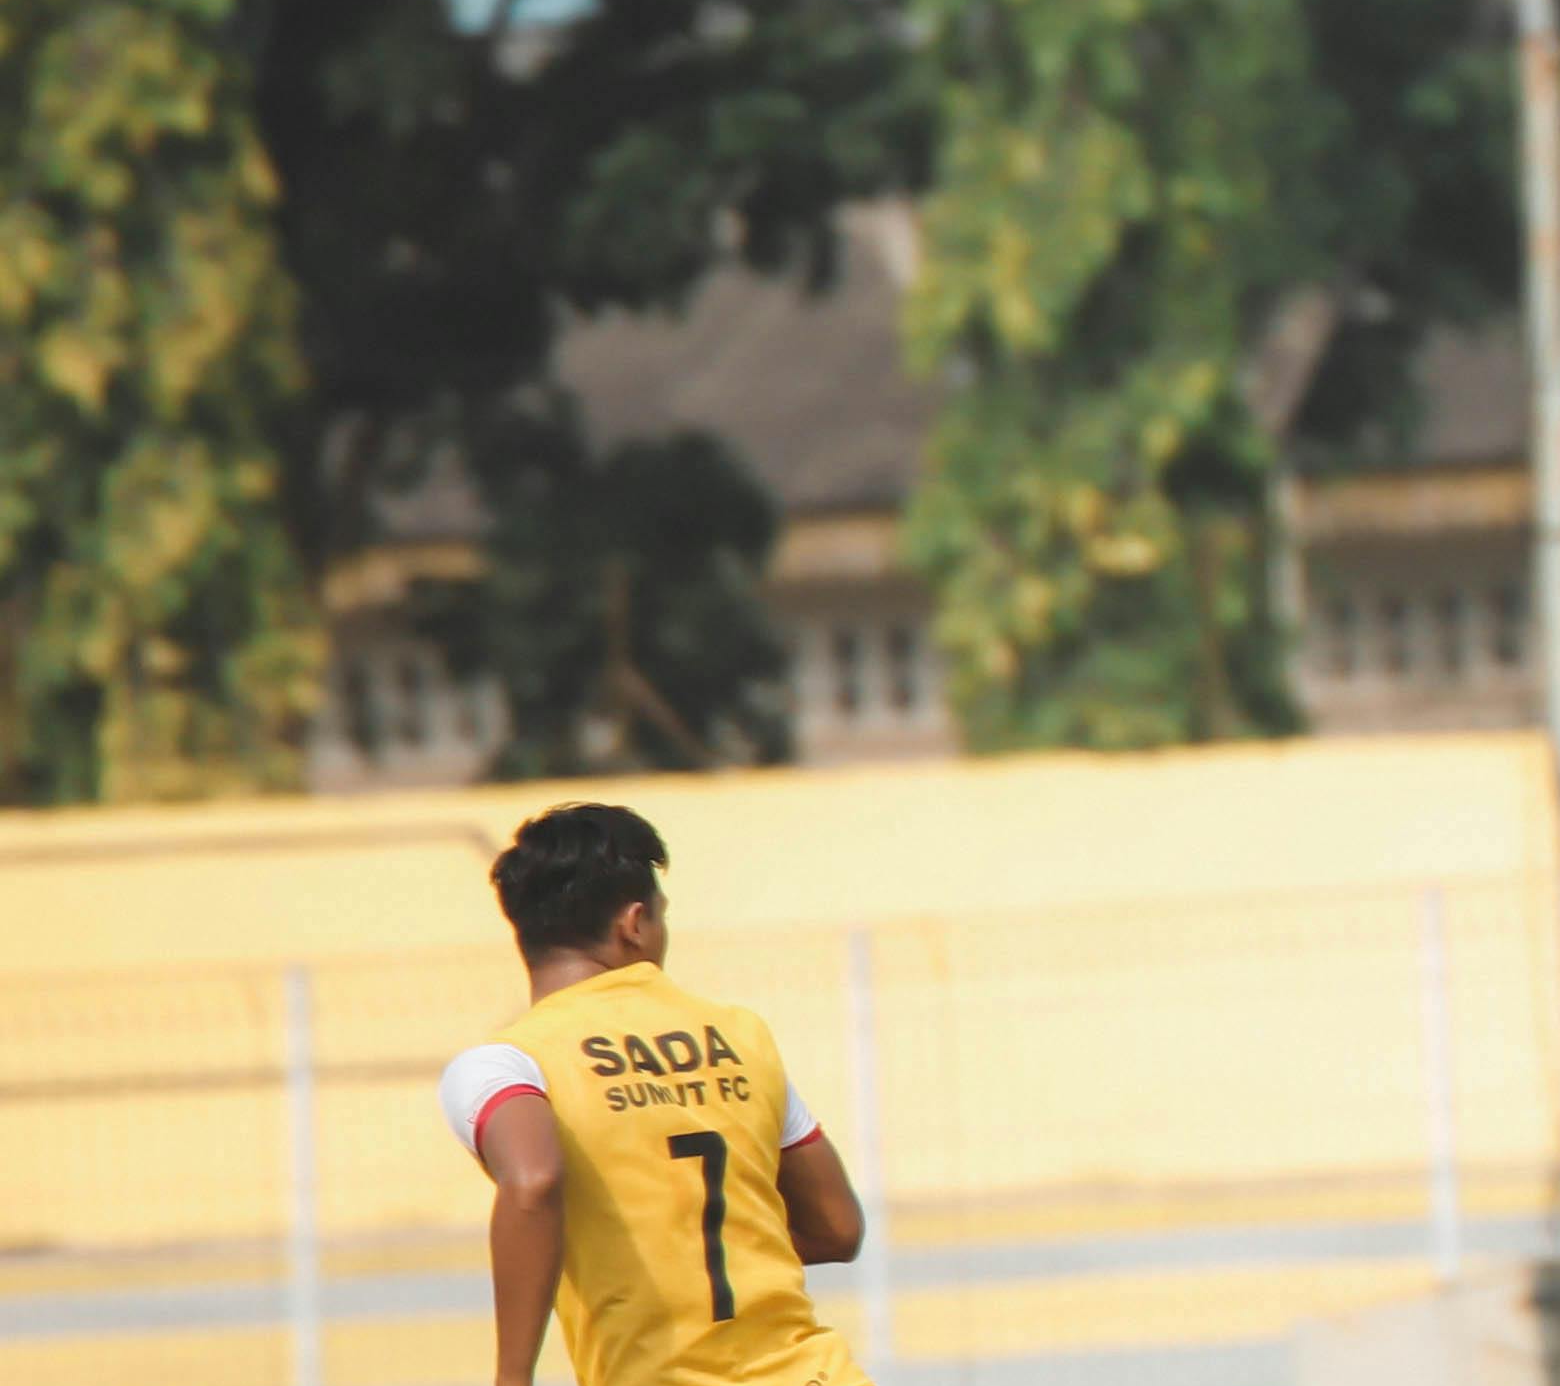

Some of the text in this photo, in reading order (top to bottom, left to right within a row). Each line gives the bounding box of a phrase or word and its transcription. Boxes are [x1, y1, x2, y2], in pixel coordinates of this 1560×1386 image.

[581, 1024, 743, 1077] SADA
[605, 1075, 750, 1112] SUMUT FC
[667, 1130, 735, 1323] 7
